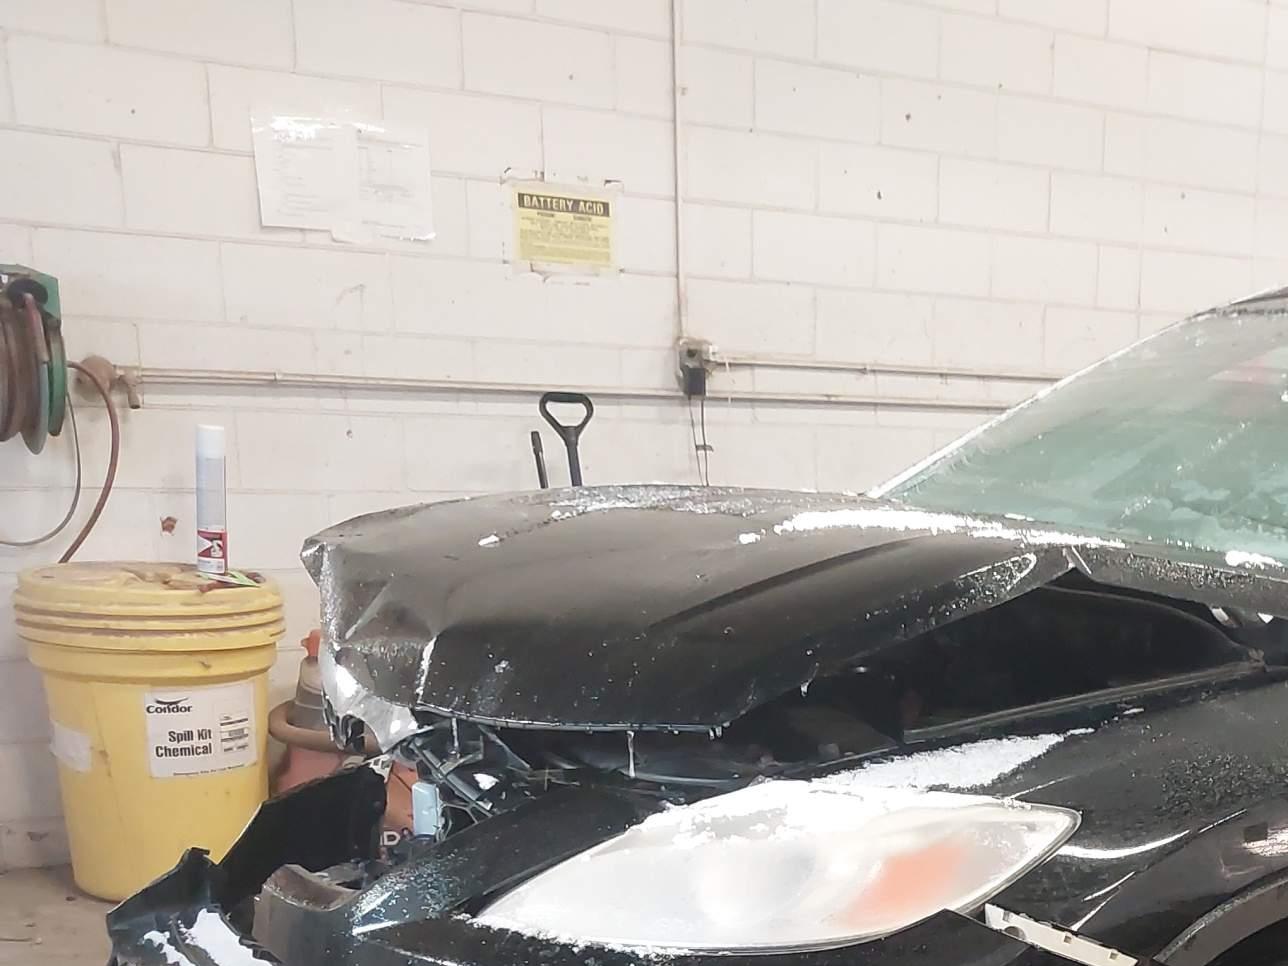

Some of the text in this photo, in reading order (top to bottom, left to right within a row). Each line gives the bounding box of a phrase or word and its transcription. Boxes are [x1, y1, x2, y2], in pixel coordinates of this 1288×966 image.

[523, 194, 604, 215] BATTERY ACID
[146, 704, 192, 714] Condor
[168, 728, 212, 744] Spill Kit
[155, 742, 212, 758] Chemical
